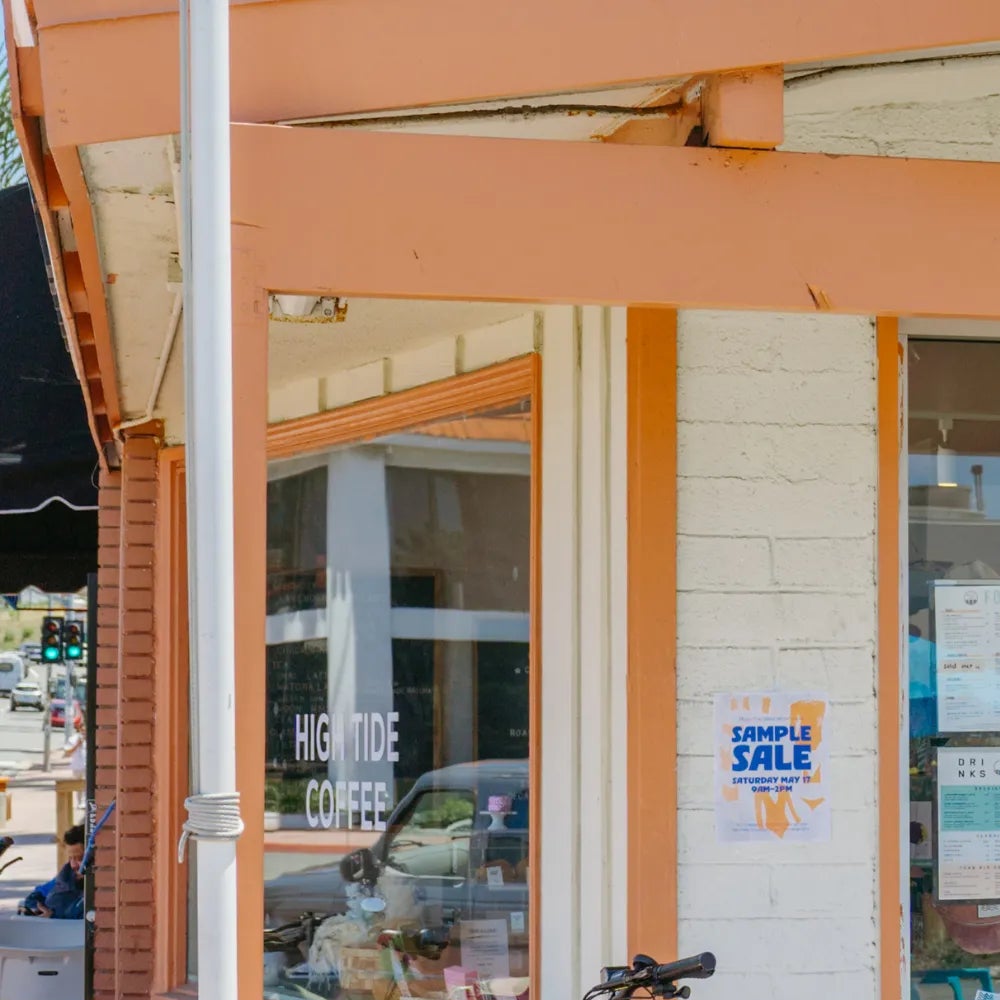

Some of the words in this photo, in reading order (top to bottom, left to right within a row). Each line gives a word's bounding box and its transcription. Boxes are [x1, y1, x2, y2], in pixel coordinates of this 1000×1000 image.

[295, 712, 345, 762] HIGH
[352, 711, 400, 762] TIDE
[731, 725, 812, 743] SAMPLE
[731, 744, 812, 772] SALE
[732, 776, 779, 785] SATURDAY
[780, 776, 800, 784] MAY
[802, 776, 811, 784] 17
[751, 785, 793, 793] 9AM-2PM
[305, 779, 387, 832] COFFEE
